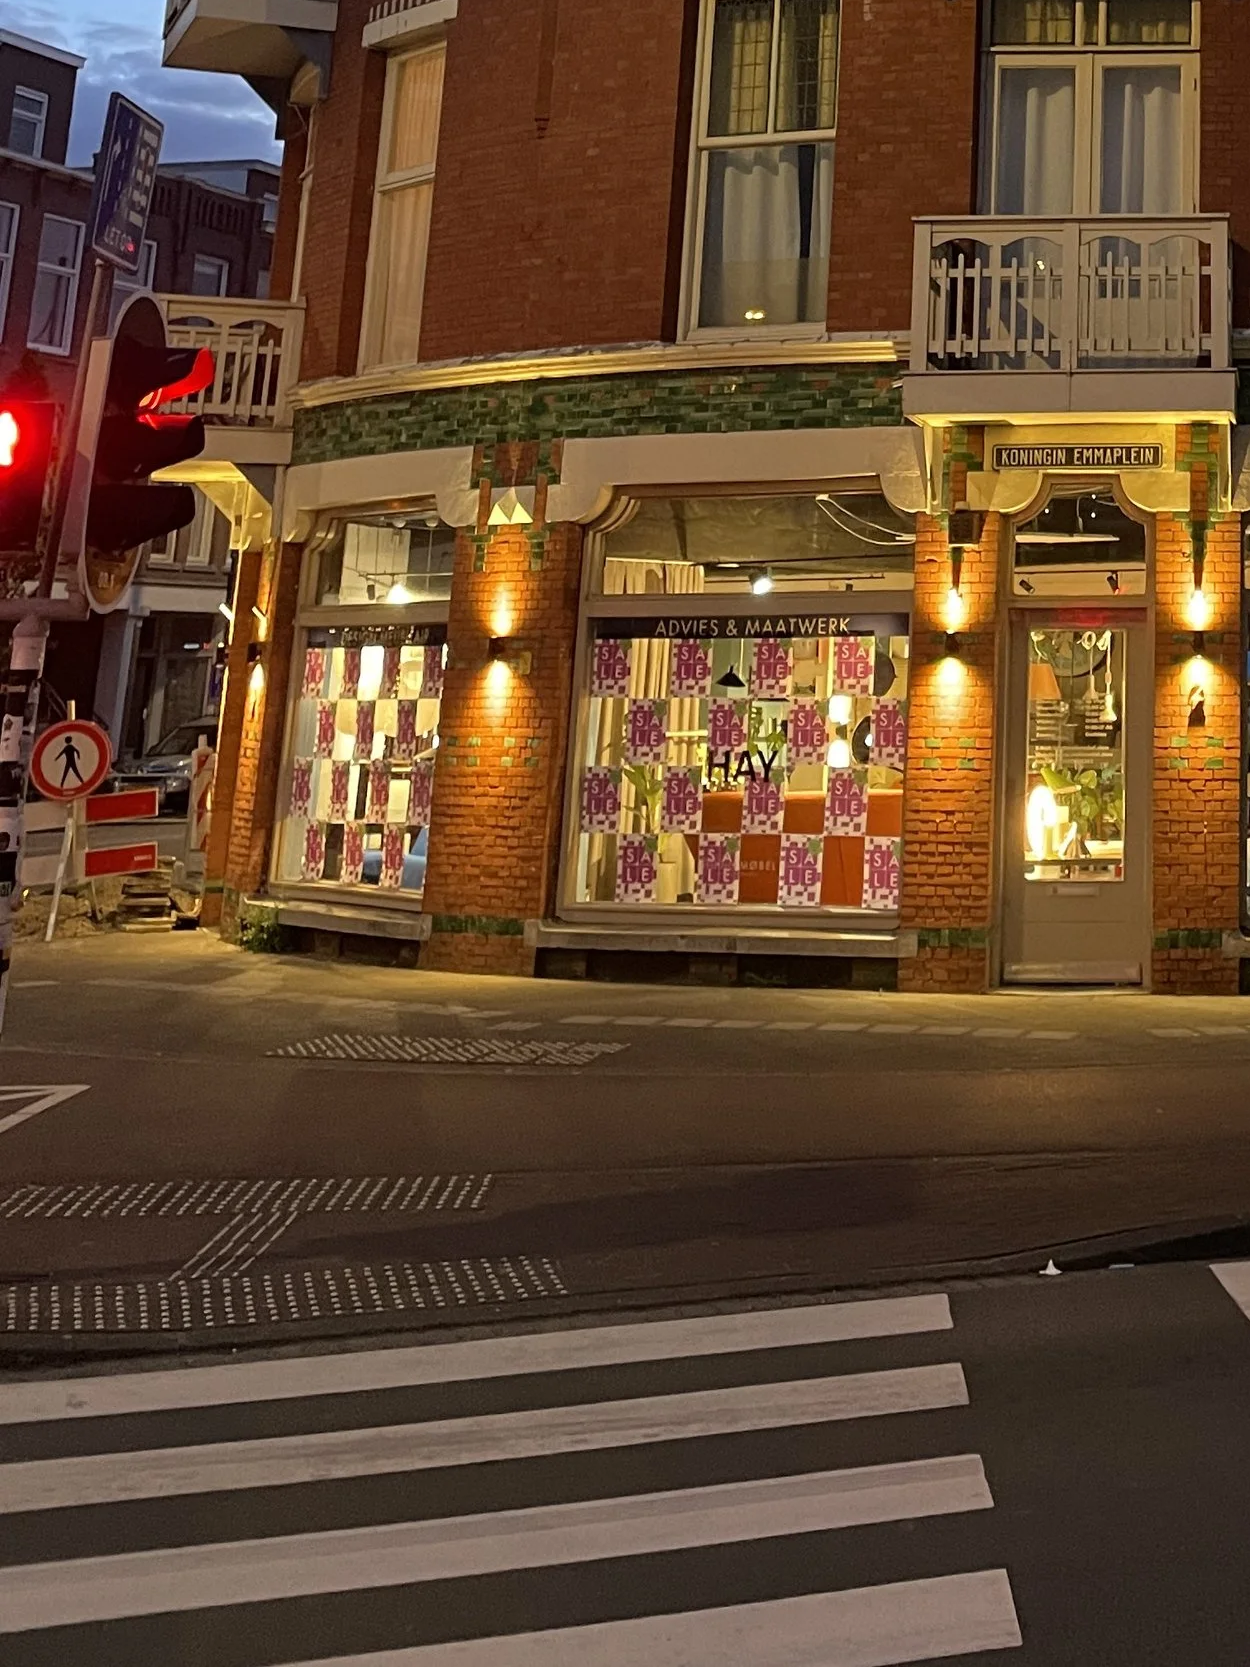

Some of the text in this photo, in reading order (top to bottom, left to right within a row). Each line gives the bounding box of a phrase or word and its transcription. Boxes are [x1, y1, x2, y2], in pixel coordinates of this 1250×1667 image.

[1001, 447, 1154, 466] KONINGIN EMMAPLEIN
[655, 617, 851, 636] ADVIES & MAATWERK
[707, 750, 779, 783] HAY
